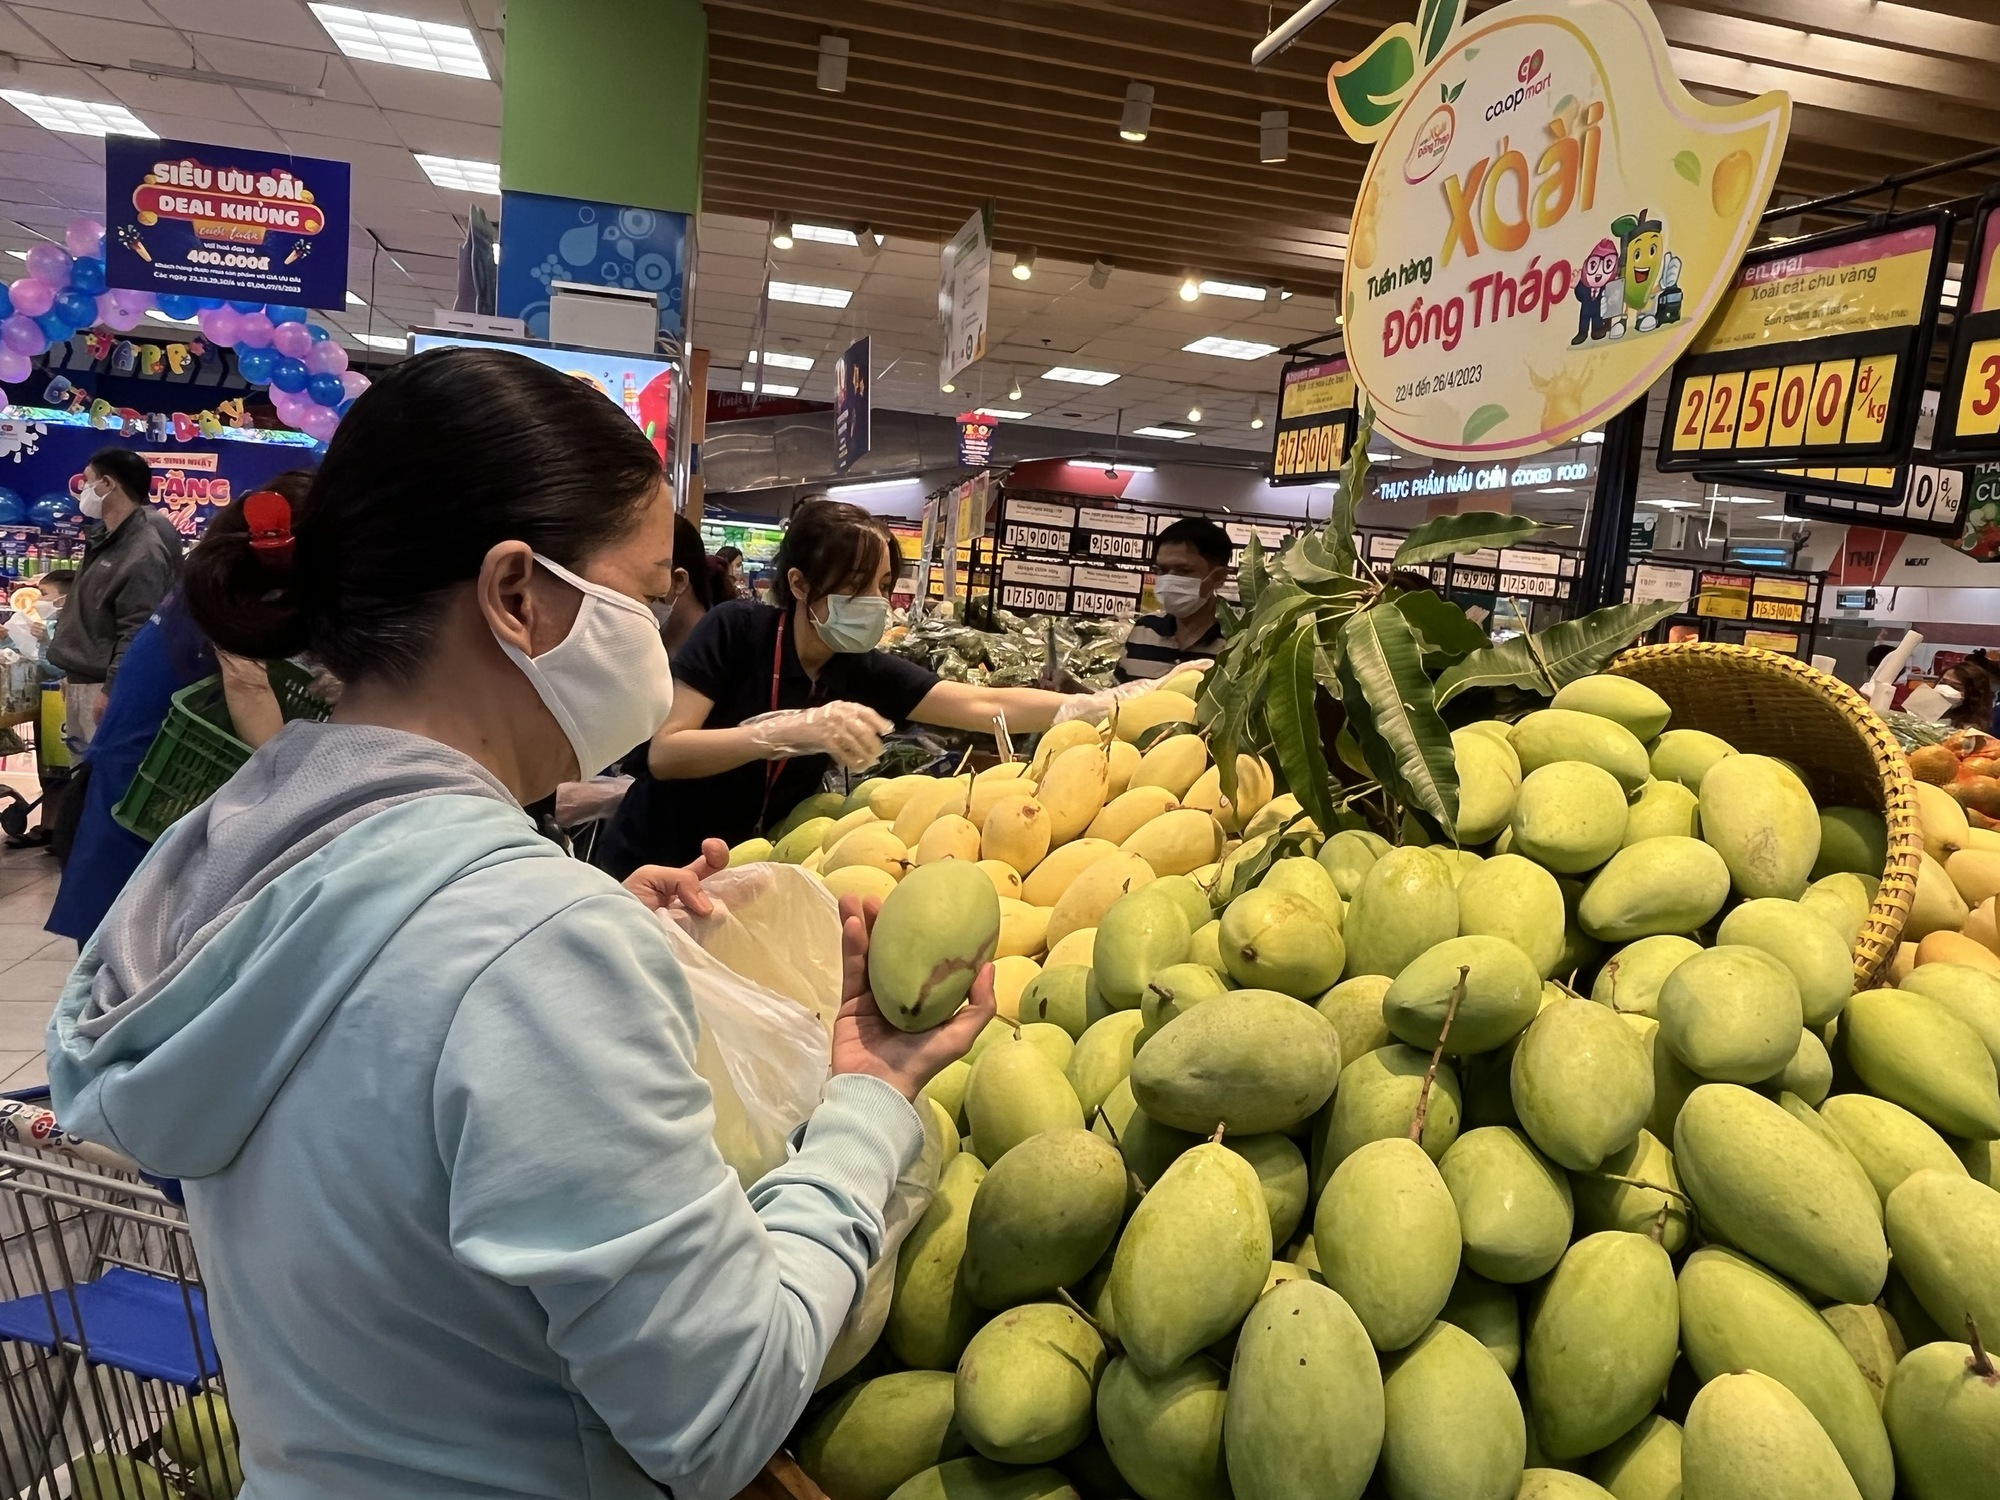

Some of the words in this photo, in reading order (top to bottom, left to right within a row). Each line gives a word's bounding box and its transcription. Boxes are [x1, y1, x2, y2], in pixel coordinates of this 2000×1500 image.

[153, 161, 211, 189] SIÊU
[217, 168, 253, 194] ƯU
[256, 173, 305, 201] ĐÃI
[159, 195, 215, 216] DEAL
[221, 202, 299, 227] KHỦNG
[187, 250, 270, 270] 400.000đ
[1399, 256, 1433, 288] hàng
[1808, 272, 1835, 291] chu
[1840, 266, 1878, 284] vàng
[1383, 297, 1464, 358] Đồng
[1468, 255, 1572, 328] Tháp
[1395, 382, 1413, 403] 22/4
[1415, 376, 1430, 397] đến
[1433, 364, 1483, 393] 26/4/2023
[1972, 355, 2000, 416] 3
[1682, 374, 1843, 435] 22.500
[1858, 367, 1887, 422] đ/kg
[1278, 433, 1329, 466] 37.500
[1411, 469, 1444, 497] PHẨM
[1447, 465, 1473, 493] NẤU
[1475, 464, 1507, 490] CHÍN
[1511, 467, 1552, 487] COOKED
[1557, 463, 1588, 482] FOOD
[1010, 528, 1058, 545] 15.900
[1092, 536, 1131, 554] 9.500
[1905, 557, 1930, 567] MEAT
[1007, 588, 1054, 607] 17.500
[1503, 576, 1545, 592] 17.500
[1078, 594, 1123, 612] 14.500
[1756, 603, 1793, 618] 15.500
